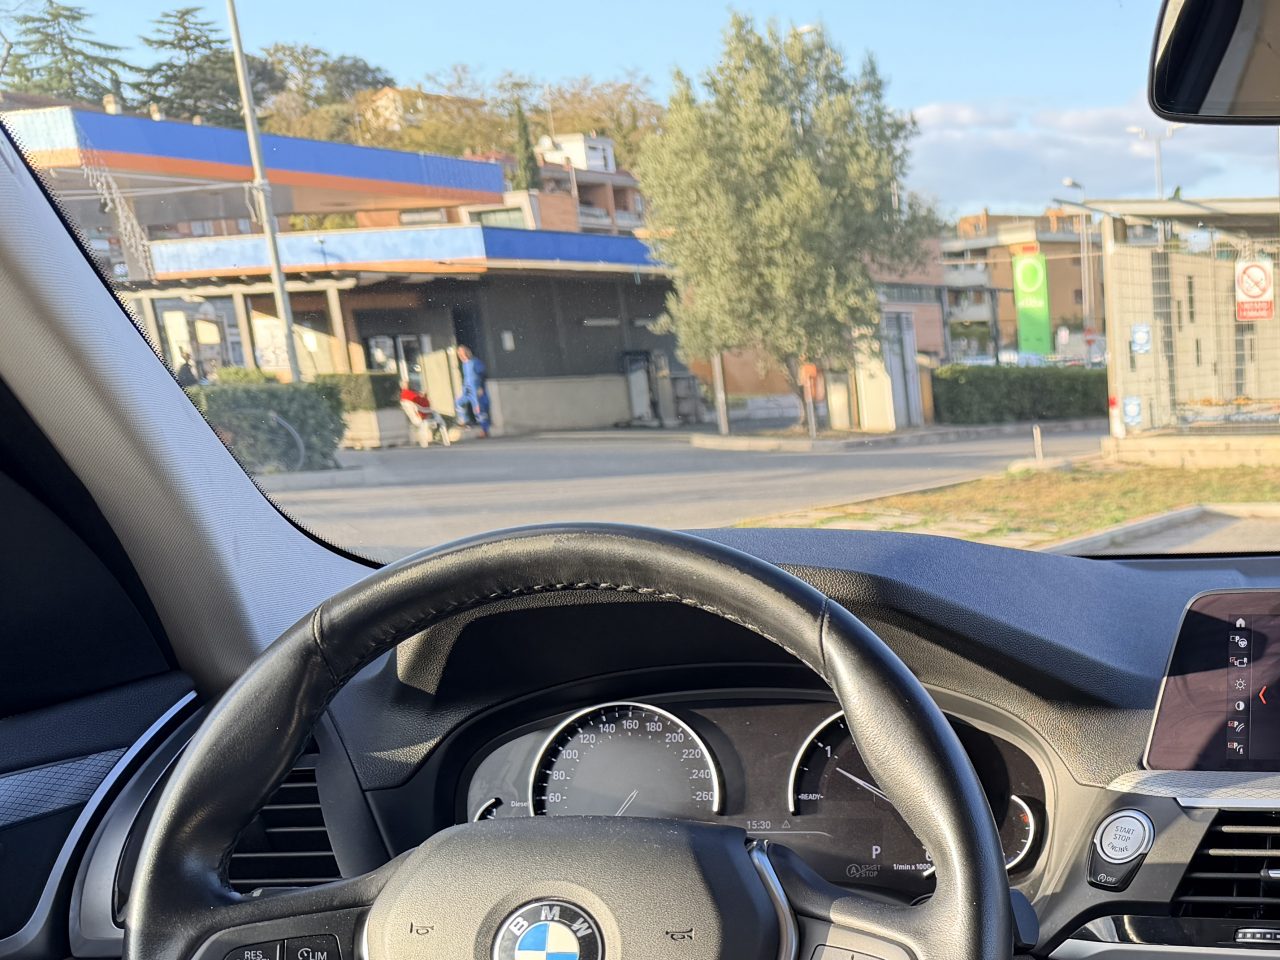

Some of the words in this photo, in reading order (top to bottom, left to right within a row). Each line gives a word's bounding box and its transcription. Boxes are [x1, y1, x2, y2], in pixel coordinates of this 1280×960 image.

[599, 723, 616, 734] 140
[622, 720, 639, 730] 160
[645, 722, 663, 732] 180
[580, 733, 596, 744] 120
[665, 733, 684, 743] 200
[562, 750, 579, 760] 100
[682, 749, 701, 759] 220
[553, 770, 566, 781] 80
[692, 769, 711, 779] 240
[549, 792, 562, 803] 60
[695, 791, 714, 802] 260
[746, 820, 771, 830] 15:30
[1114, 825, 1135, 836] START
[1113, 833, 1131, 843] STOP
[871, 845, 881, 859] P
[1107, 841, 1129, 853] ENGINE
[862, 870, 879, 878] STOP
[508, 905, 593, 938] BMW
[244, 950, 263, 960] RES
[309, 951, 328, 960] LIM
